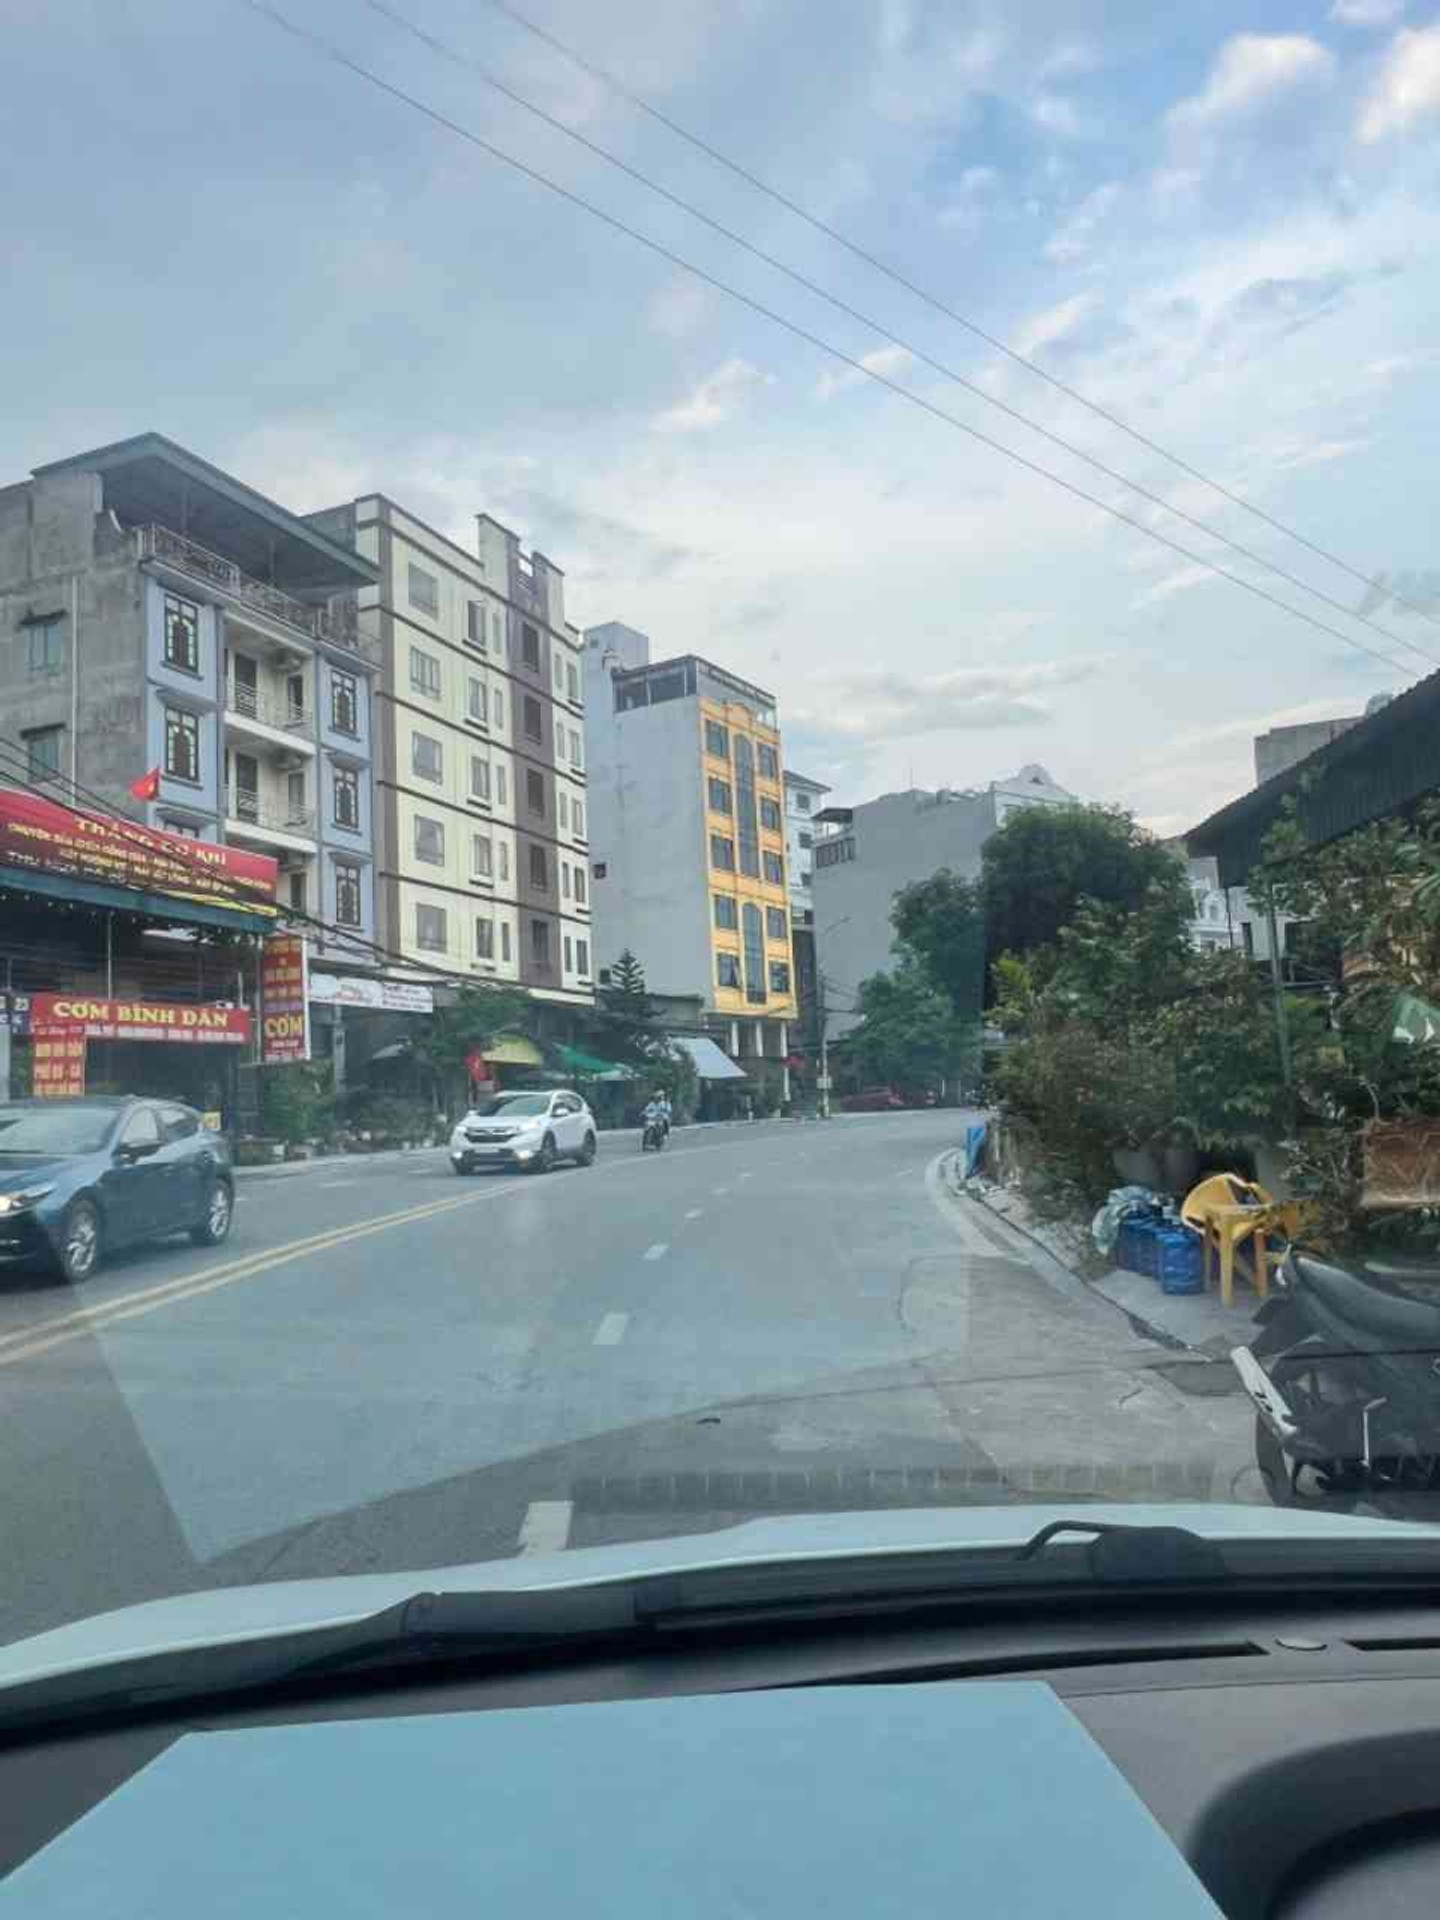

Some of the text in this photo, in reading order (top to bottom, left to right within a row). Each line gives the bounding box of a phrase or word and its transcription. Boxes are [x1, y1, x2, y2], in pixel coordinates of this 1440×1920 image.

[53, 1001, 228, 1027] CƠM BÌNH DÂN
[265, 1013, 303, 1037] CƠM
